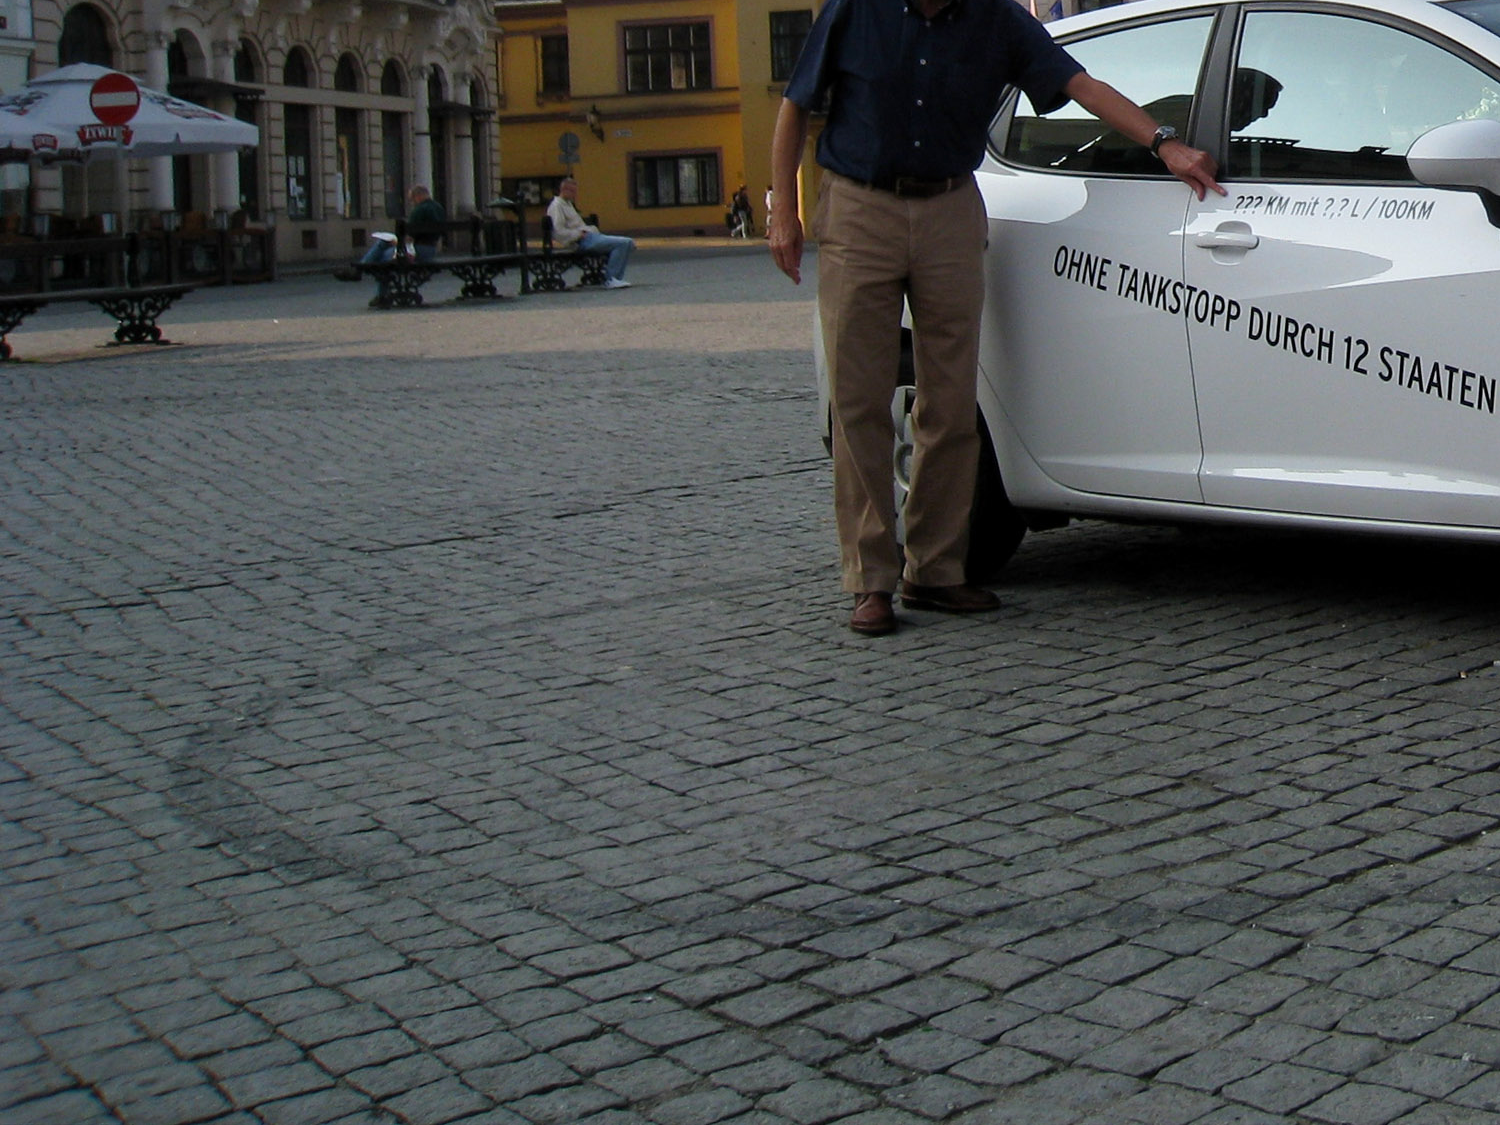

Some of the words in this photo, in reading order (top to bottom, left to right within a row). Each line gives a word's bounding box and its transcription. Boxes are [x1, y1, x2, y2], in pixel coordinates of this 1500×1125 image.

[1233, 195, 1263, 216] ???
[1263, 196, 1289, 216] KM
[1291, 197, 1319, 217] mit
[1378, 199, 1436, 221] 100KM
[1053, 244, 1113, 293] OHNE
[1117, 263, 1242, 334] TANKSTOPP
[1248, 306, 1335, 365] DURCH
[1343, 335, 1369, 376] 12
[1377, 345, 1498, 415] STAATEN
